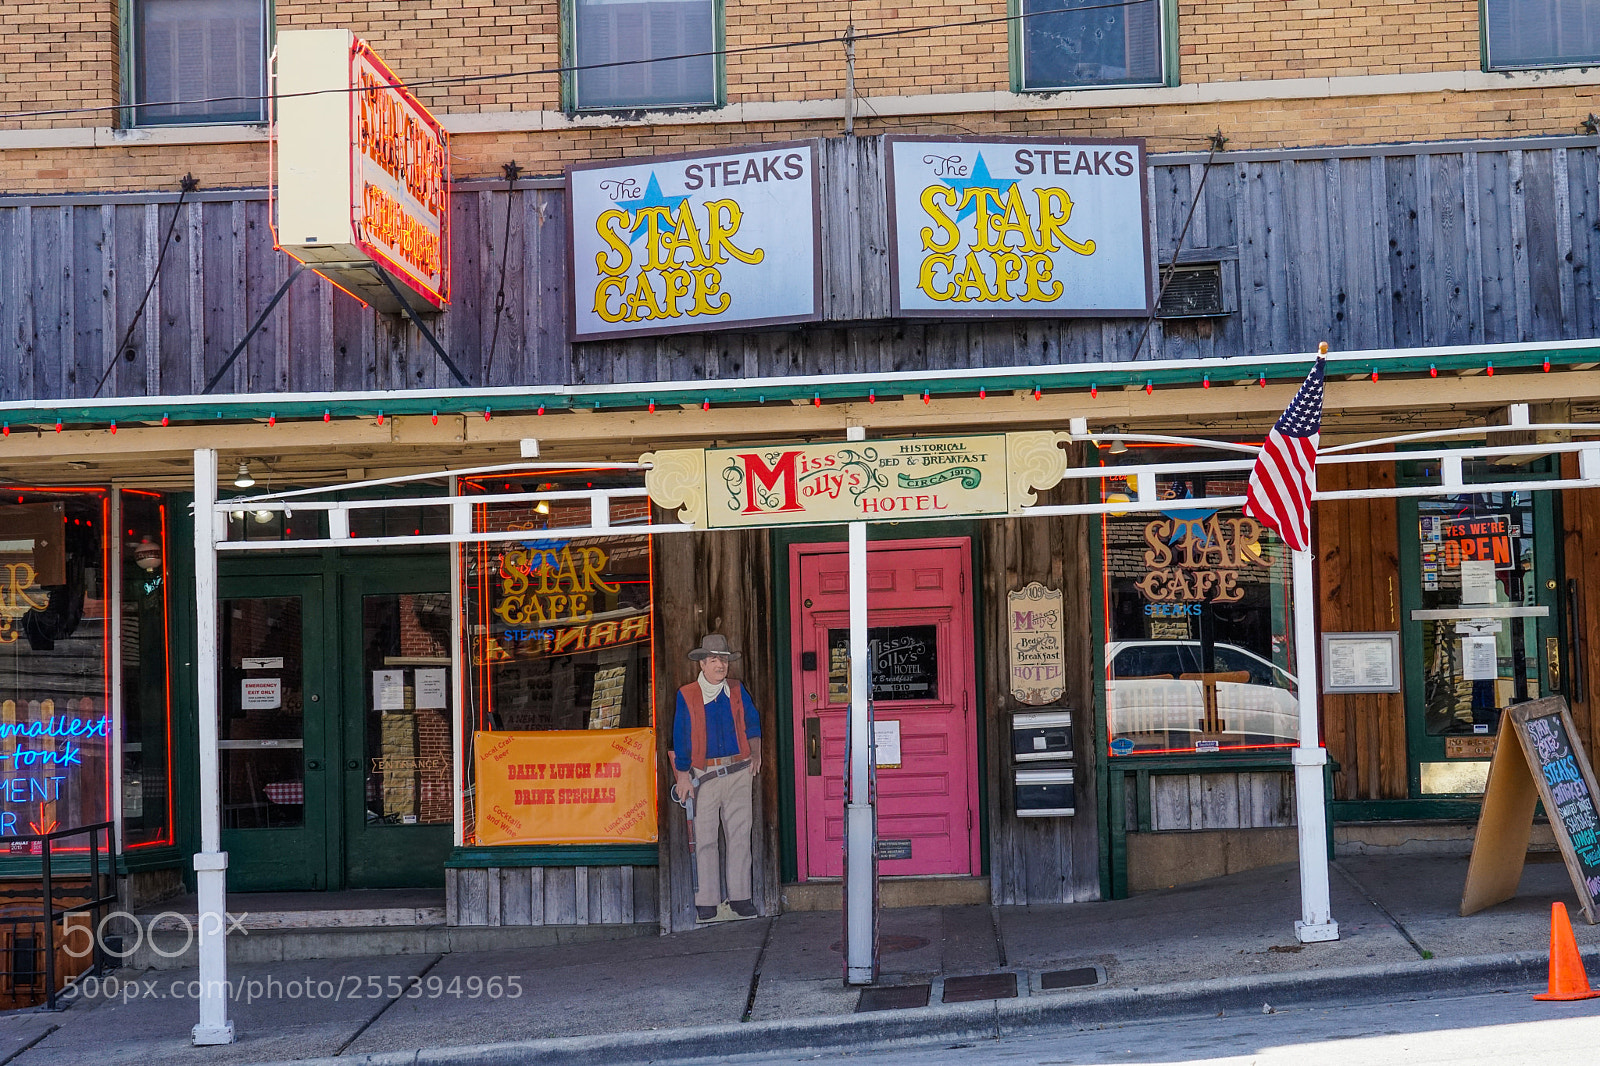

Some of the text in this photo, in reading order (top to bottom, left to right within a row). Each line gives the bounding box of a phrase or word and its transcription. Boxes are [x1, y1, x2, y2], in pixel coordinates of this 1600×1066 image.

[684, 154, 804, 190] STEAKS
[923, 155, 968, 176] The
[1015, 149, 1134, 176] STEAKS
[600, 179, 641, 200] The
[920, 182, 1096, 255] STAR
[596, 198, 764, 276] STAR
[917, 251, 1064, 302] CAFE
[592, 267, 731, 323] CAFE
[900, 443, 966, 453] HISTORICAL
[879, 454, 988, 467] BED & BREAKFAST
[907, 468, 972, 487] CIRCA 1910
[861, 495, 948, 513] HOTEL
[1445, 525, 1466, 537] YES
[1470, 522, 1506, 535] WE'RE
[1144, 512, 1276, 569] STAR
[1444, 536, 1510, 567] OPEN
[502, 543, 620, 596] STAR
[1133, 569, 1245, 603] CAFE
[493, 594, 594, 625] CAFE
[1144, 604, 1202, 615] STEAKS
[504, 629, 555, 641] STEAKS
[1017, 651, 1060, 663] Breakfast
[894, 664, 922, 674] HOTEL
[1014, 665, 1062, 681] HOTEL
[480, 735, 515, 761] Local Craft
[611, 741, 644, 763] Longnecks
[623, 736, 642, 750] $2.50
[378, 760, 439, 770] ENTRANCE
[493, 749, 510, 762] Beer
[508, 762, 621, 780] DAILY LUNCH AND
[1543, 755, 1580, 786] STEAKS
[515, 787, 616, 805] DRINK SPECIALS
[486, 813, 517, 838] and Wine
[493, 805, 522, 829] Cocktails
[604, 815, 624, 833] Lunch
[616, 818, 637, 836] UNDER
[1569, 828, 1598, 852] LUNCH
